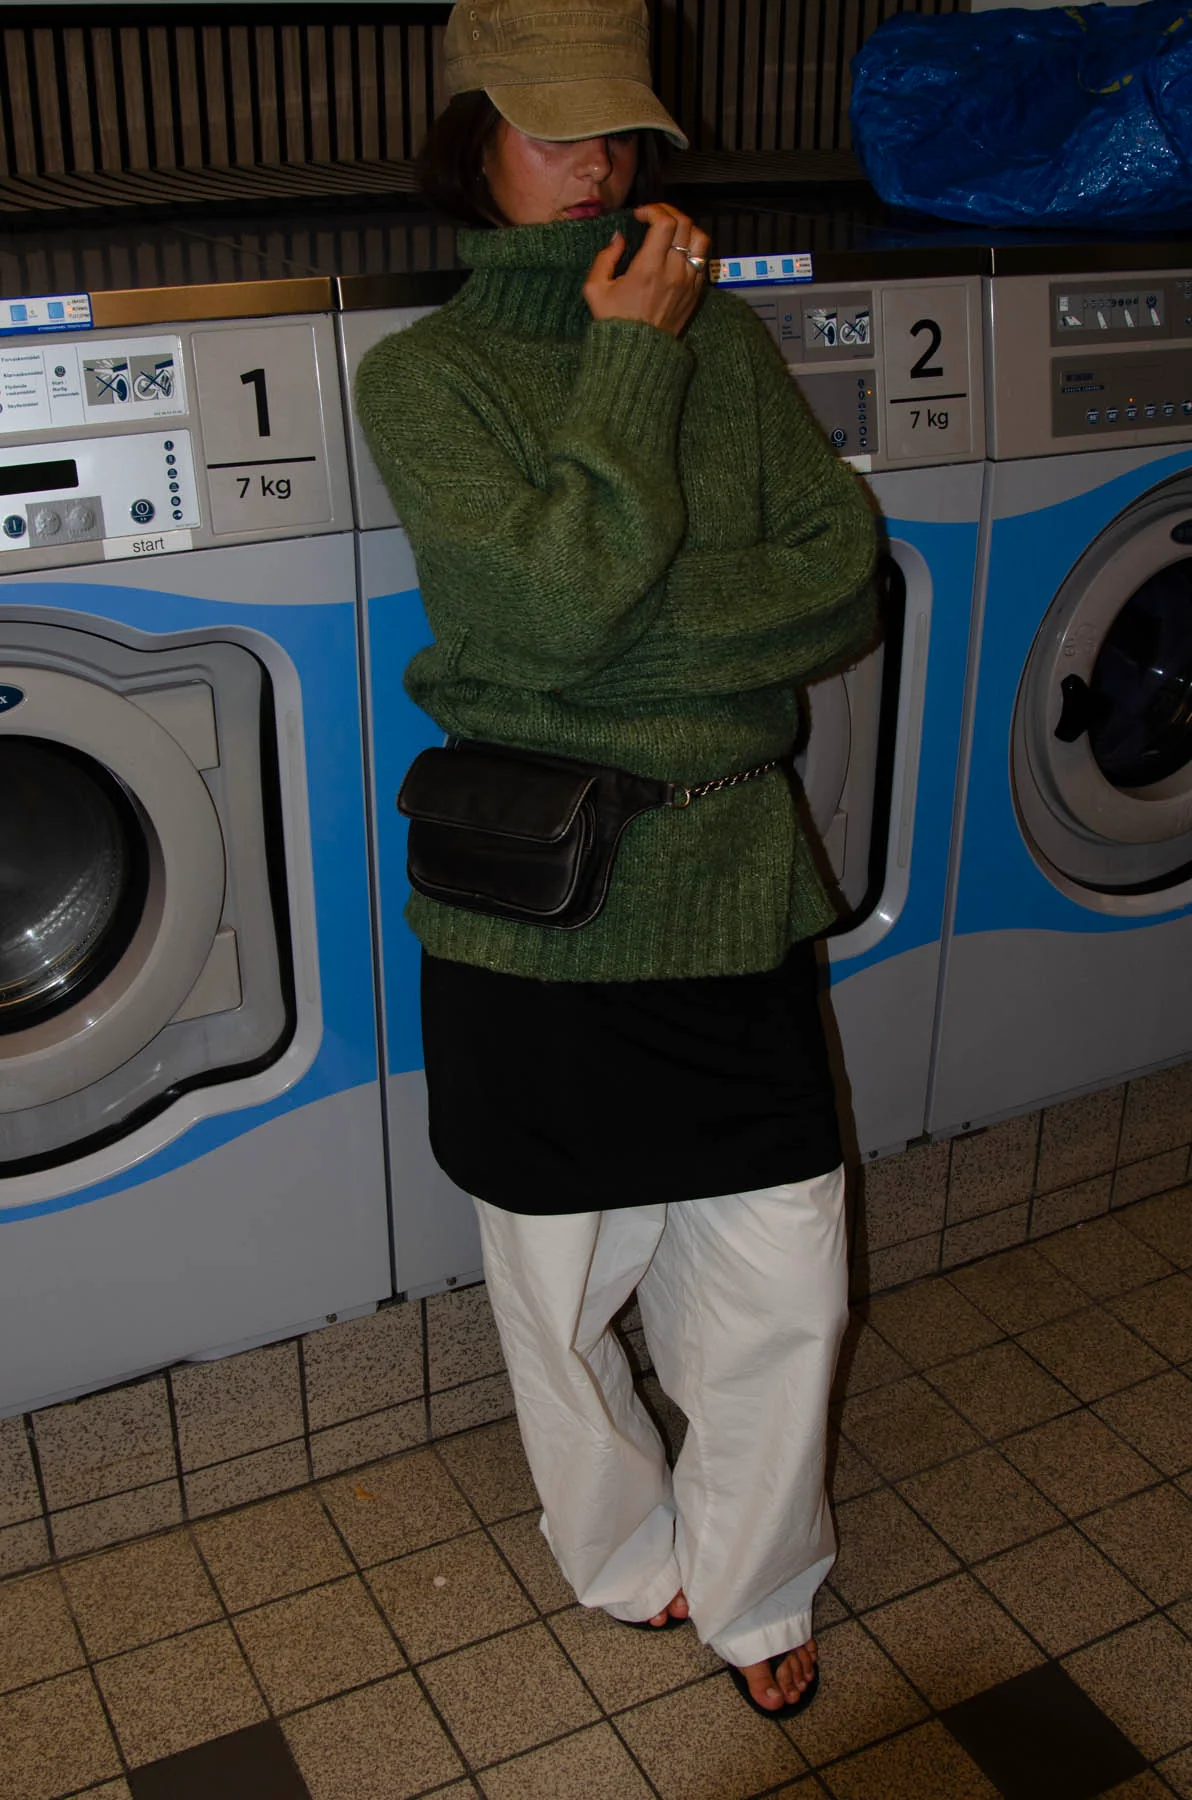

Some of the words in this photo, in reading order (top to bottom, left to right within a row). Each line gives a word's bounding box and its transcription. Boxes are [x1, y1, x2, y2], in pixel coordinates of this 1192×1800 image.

[910, 319, 943, 378] 2
[240, 368, 270, 436] 1
[910, 410, 920, 429] 7
[927, 408, 948, 429] kg
[236, 477, 250, 498] 7
[261, 475, 292, 500] kg
[132, 536, 165, 553] start
